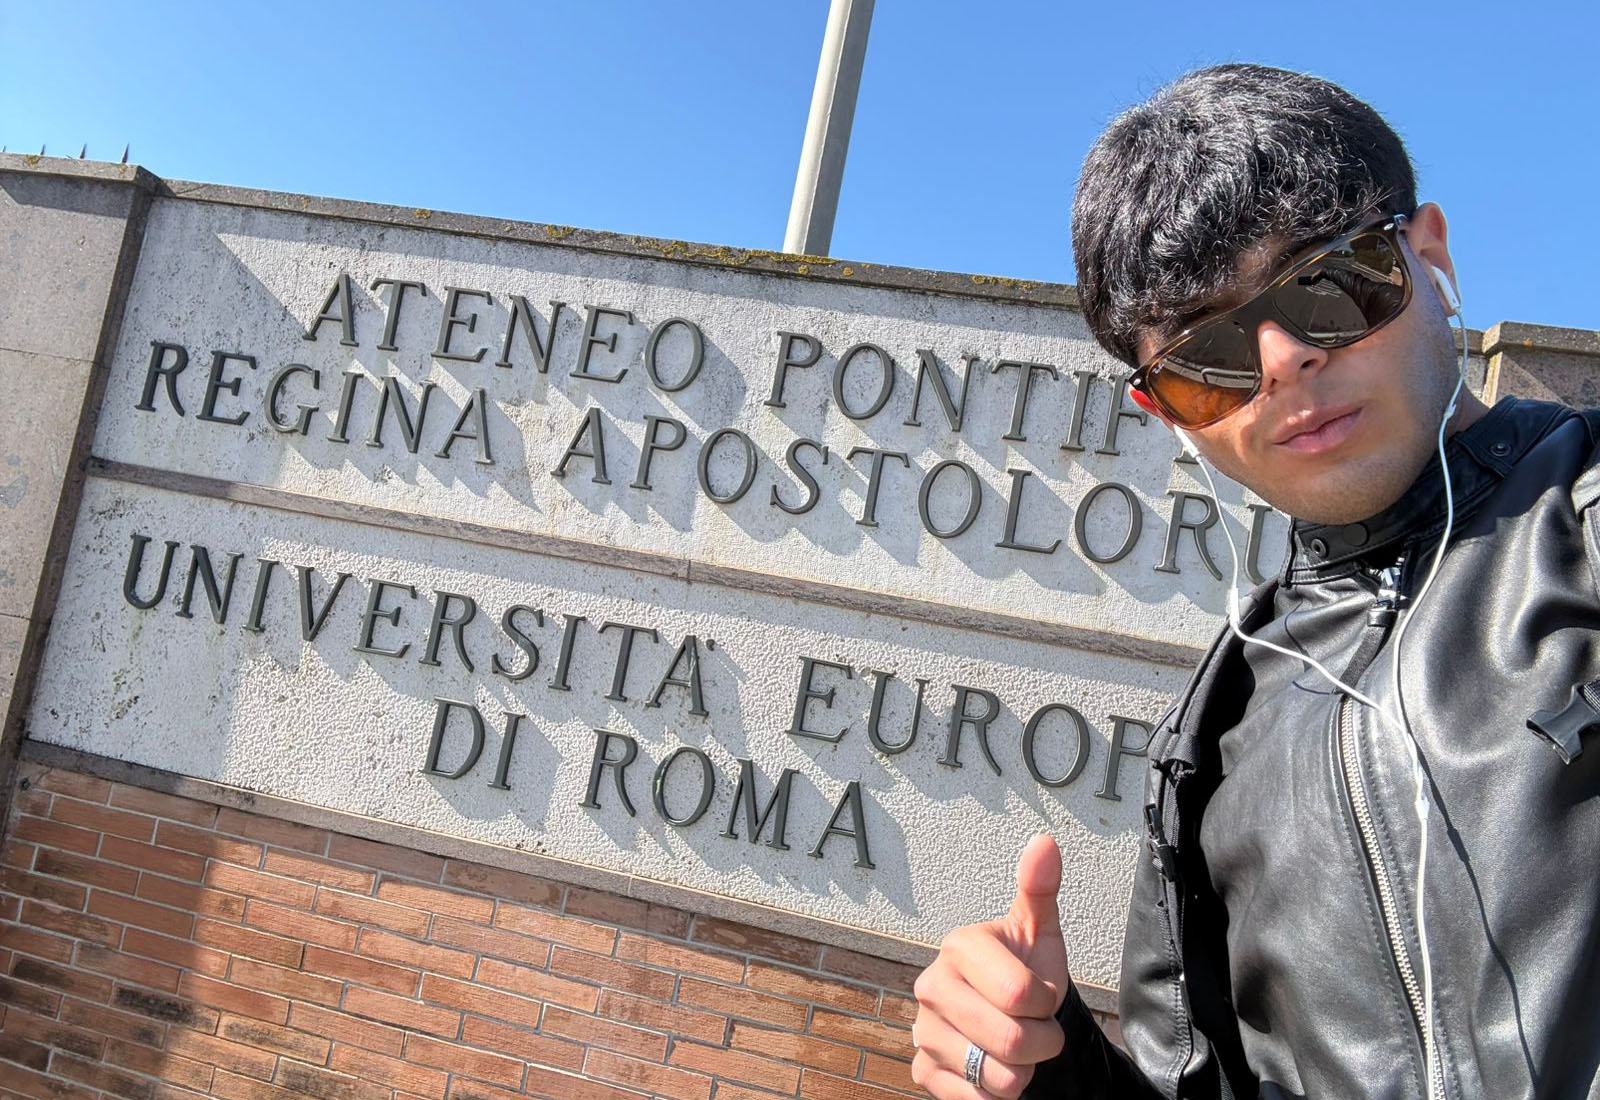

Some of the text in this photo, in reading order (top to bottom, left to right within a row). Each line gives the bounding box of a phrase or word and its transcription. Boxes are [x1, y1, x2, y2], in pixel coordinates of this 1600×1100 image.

[135, 340, 494, 465] REGINA
[302, 273, 1200, 464] ATENEO PONTIF
[419, 696, 876, 870] DI ROMA
[785, 655, 1155, 801] EUROP
